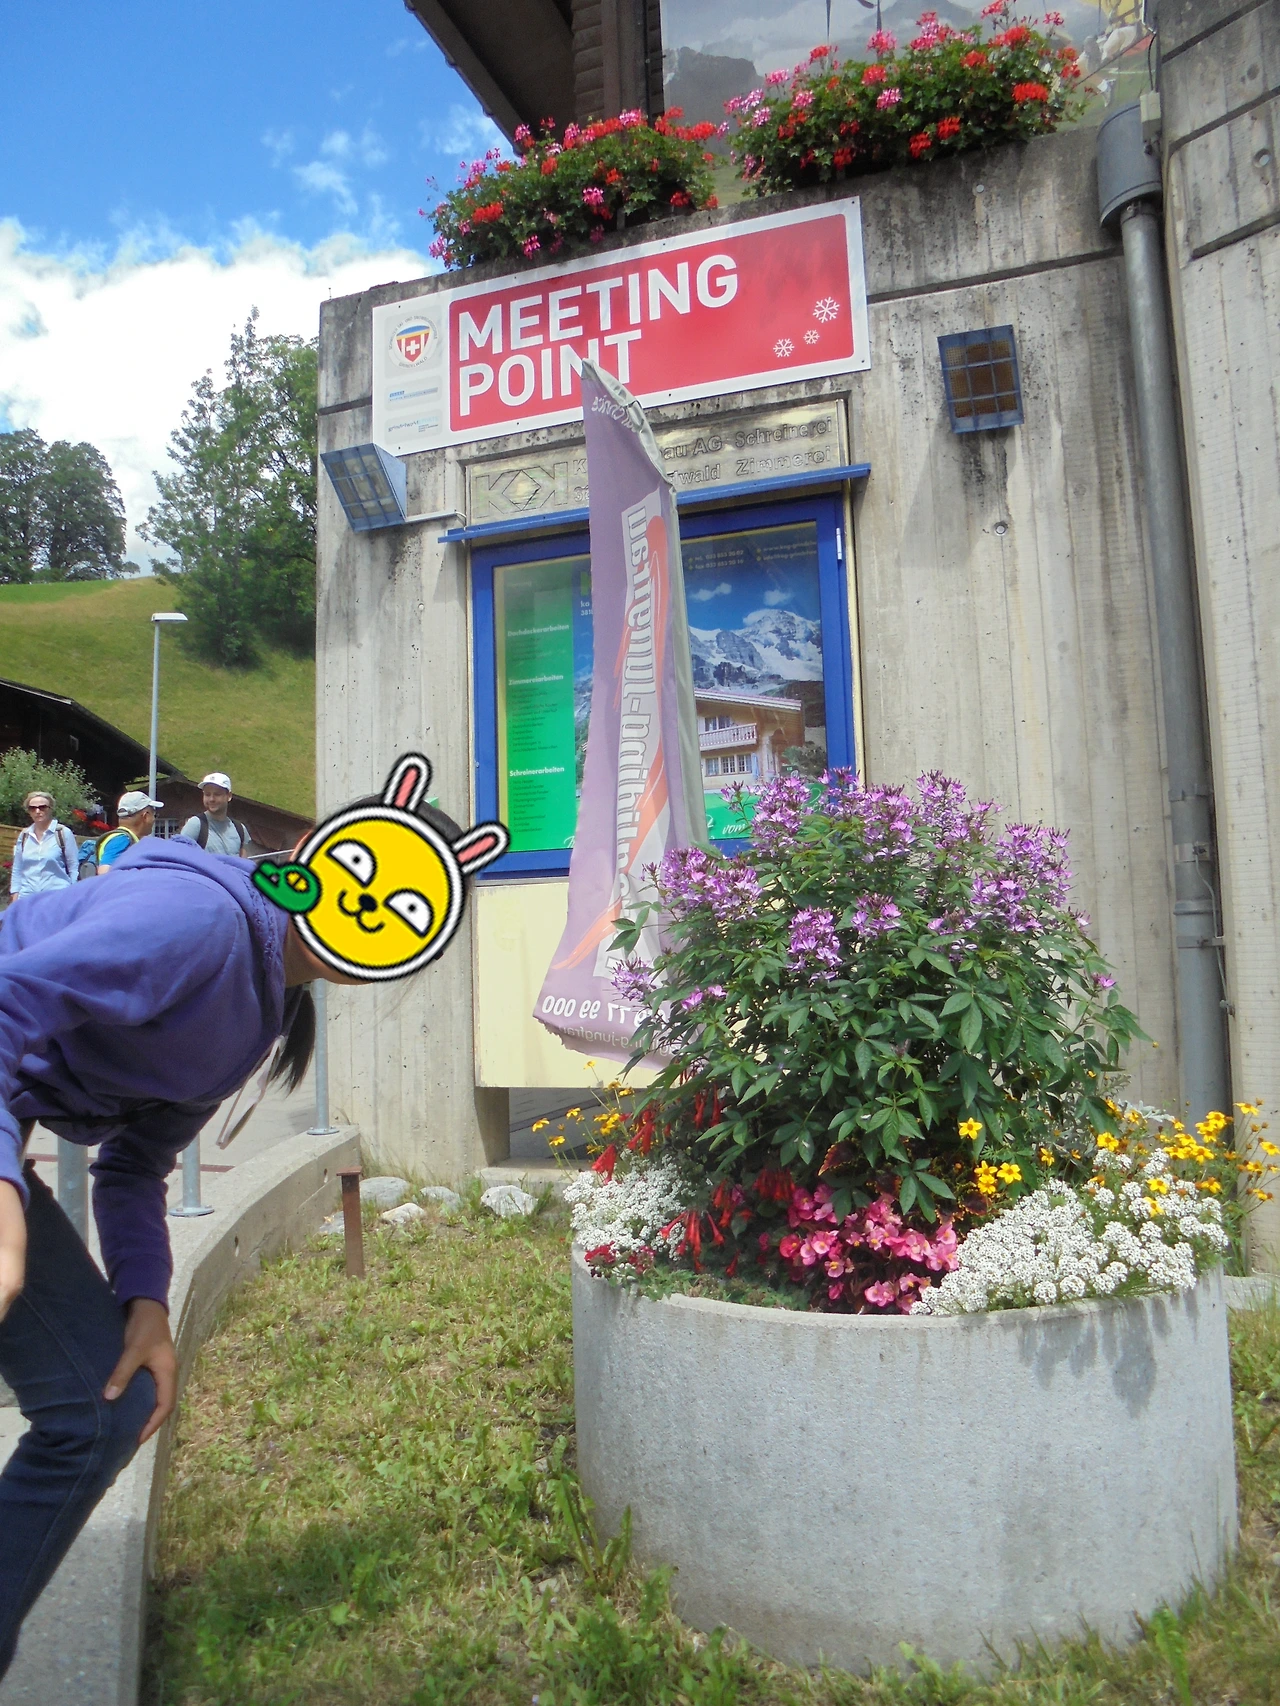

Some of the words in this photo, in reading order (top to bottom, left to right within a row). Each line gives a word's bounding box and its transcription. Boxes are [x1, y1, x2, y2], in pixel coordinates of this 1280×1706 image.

[459, 254, 738, 361] MEETING
[459, 329, 642, 417] POINT
[693, 435, 723, 456] AG
[735, 416, 832, 448] Schreinerei
[736, 446, 831, 476] Zimmerei
[509, 766, 565, 777] Schreinerarbeiten
